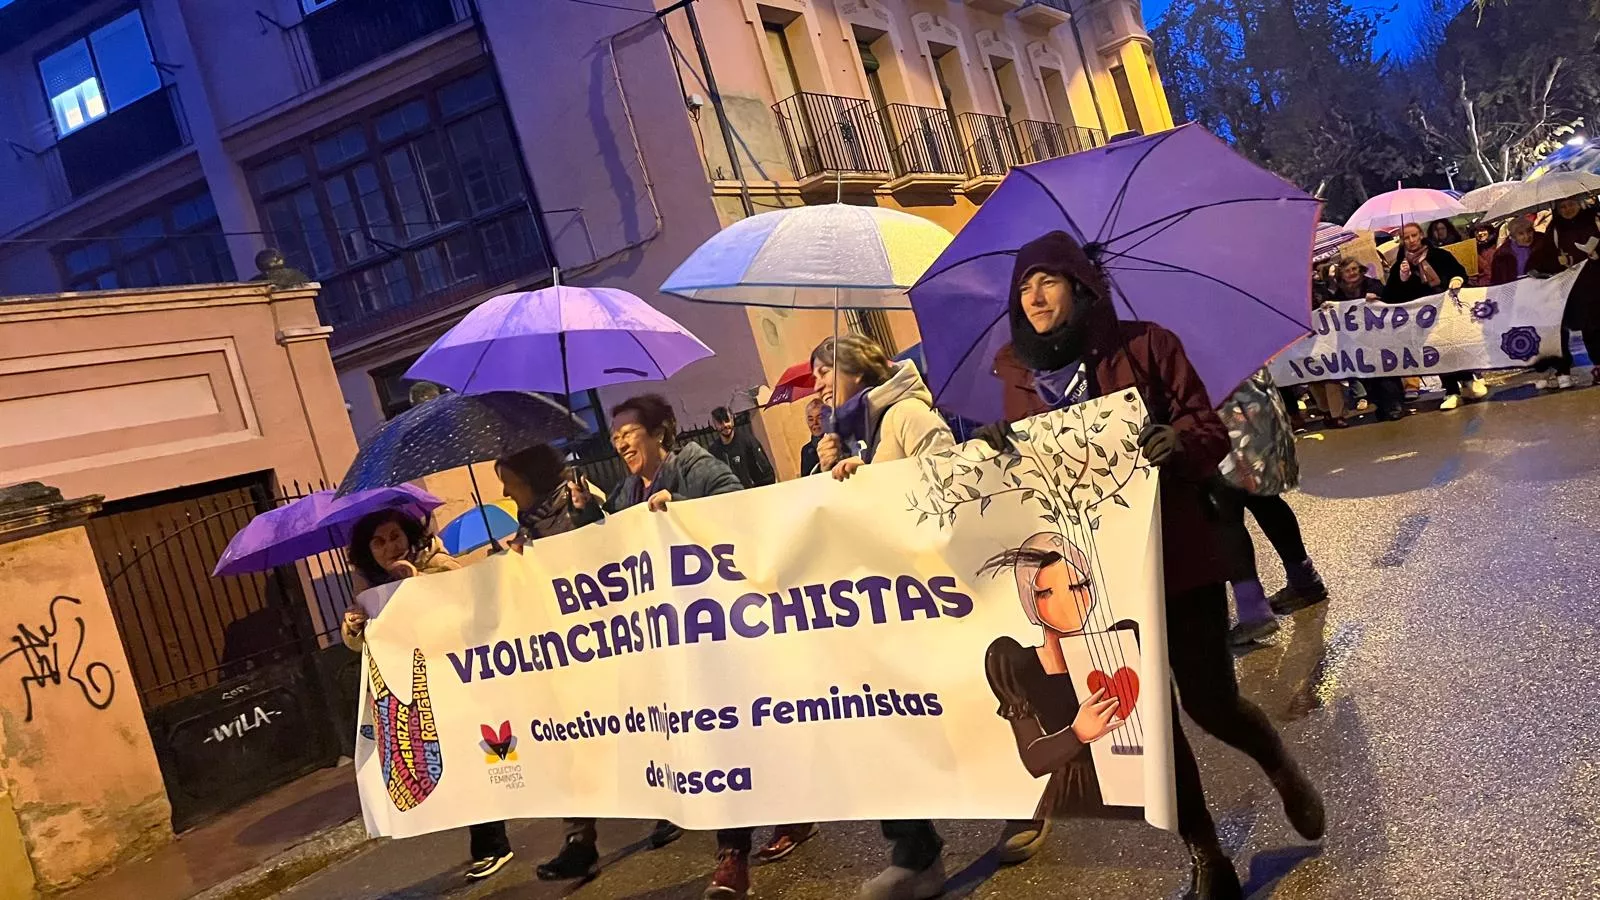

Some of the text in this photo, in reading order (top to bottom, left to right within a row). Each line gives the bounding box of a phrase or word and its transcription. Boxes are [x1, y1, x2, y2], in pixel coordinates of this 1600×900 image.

[1288, 345, 1440, 379] IGUALDAD
[551, 543, 747, 615] BASTA DE
[446, 610, 644, 684] VIOLENCIAS
[645, 575, 974, 649] MACHISTAS
[397, 703, 419, 781] AMENAZAS
[530, 709, 621, 742] Colectivo
[625, 706, 646, 734] de
[751, 683, 944, 727] Feministas
[489, 772, 523, 785] FEMINISTA
[645, 760, 665, 788] de
